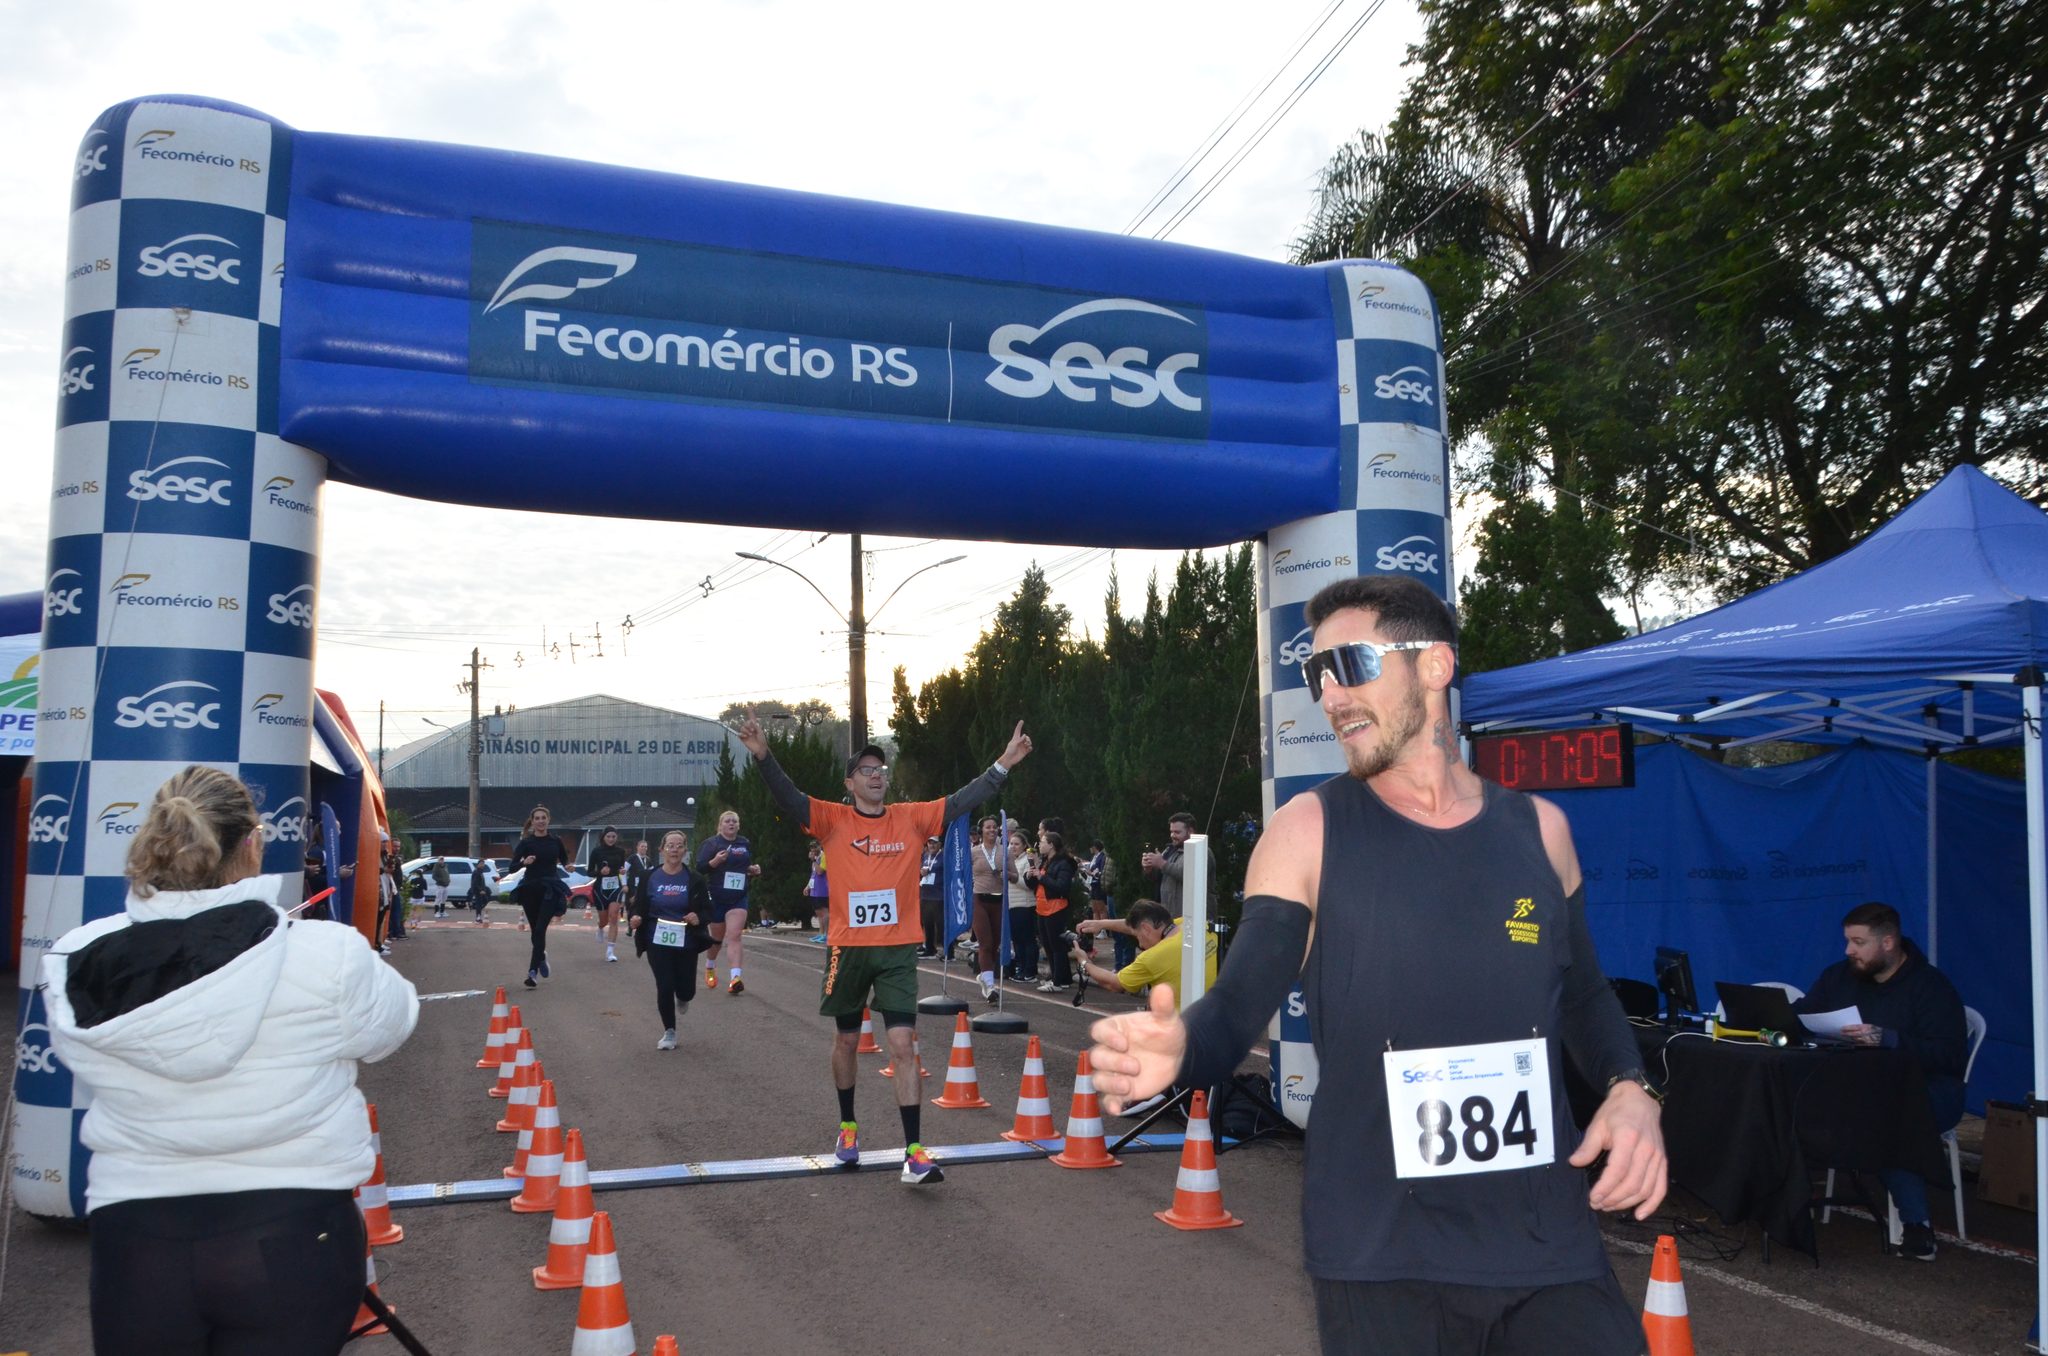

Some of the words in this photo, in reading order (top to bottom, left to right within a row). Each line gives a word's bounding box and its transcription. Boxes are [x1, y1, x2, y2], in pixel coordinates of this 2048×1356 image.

[141, 146, 235, 168] Fecomércio
[239, 158, 261, 174] RS
[95, 258, 112, 272] RS
[137, 247, 241, 285] Sesc
[1364, 299, 1421, 316] Fecomércio
[524, 310, 835, 380] Fecomércio
[851, 343, 918, 388] RS
[985, 323, 1202, 412] Sesc
[128, 367, 223, 387] Fecomércio
[227, 374, 250, 390] RS
[1374, 375, 1434, 406] Sesc
[1373, 467, 1431, 483] Fecomércio
[82, 480, 99, 494] RS
[126, 470, 232, 506] Sesc
[1275, 556, 1331, 576] Fecomércio
[1334, 555, 1352, 567] RS
[1375, 546, 1439, 575] Sesc
[117, 592, 213, 609] Fecomércio
[218, 596, 240, 611] RS
[266, 594, 313, 629] Ses
[1279, 641, 1313, 666] Se
[0, 713, 36, 731] PE
[69, 706, 87, 720] RS
[114, 697, 221, 730] Sesc
[10, 738, 35, 751] pa
[478, 737, 540, 755] GINÁSIO
[545, 740, 633, 754] MUNICIPAL
[638, 740, 658, 754] 29
[662, 740, 682, 754] DE
[686, 740, 721, 754] ABRI
[1279, 732, 1336, 746] Fecomércio
[730, 879, 741, 888] 17
[855, 903, 892, 925] 973
[1505, 920, 1540, 932] FAVARETO
[661, 931, 677, 944] 90
[825, 955, 838, 996] adidas
[1416, 1090, 1538, 1166] 884
[44, 1169, 63, 1183] RS
